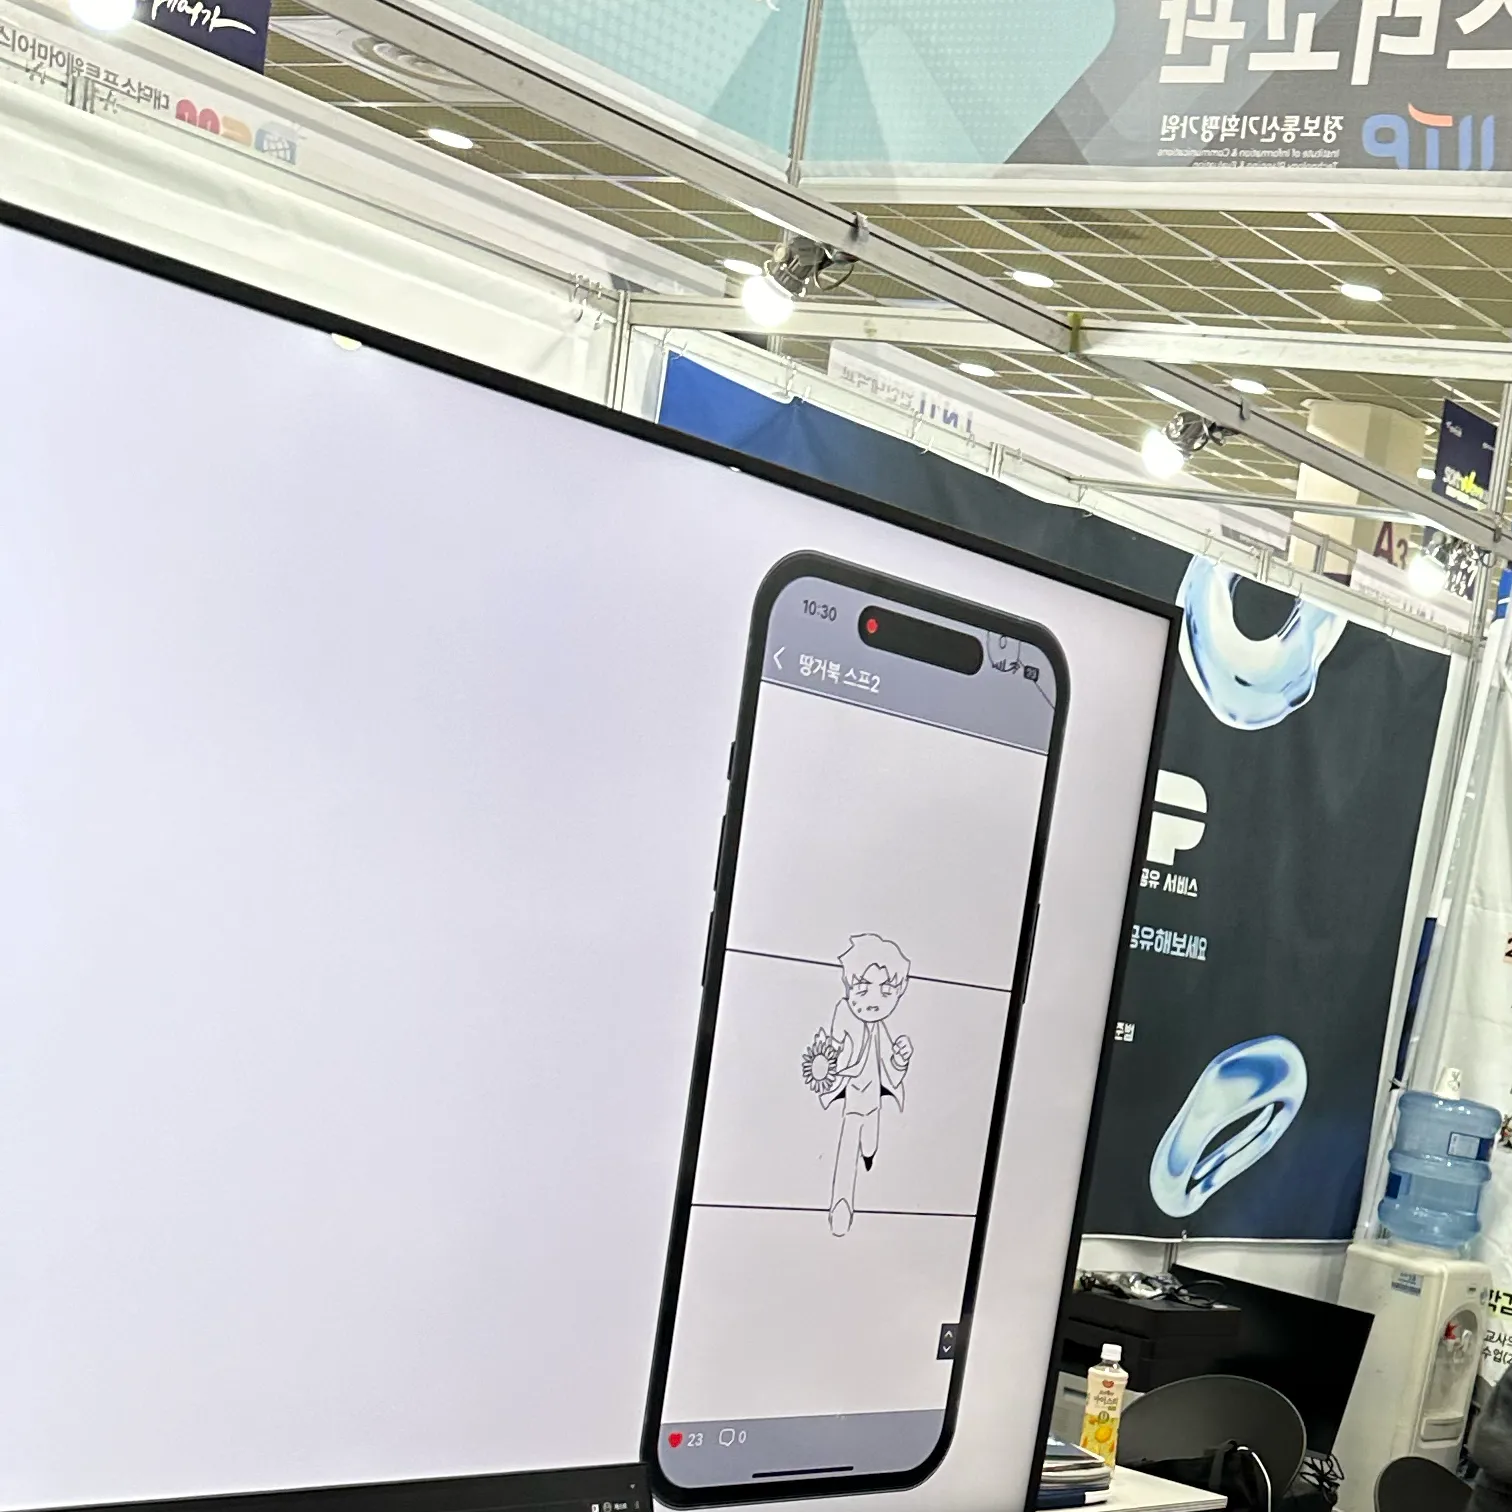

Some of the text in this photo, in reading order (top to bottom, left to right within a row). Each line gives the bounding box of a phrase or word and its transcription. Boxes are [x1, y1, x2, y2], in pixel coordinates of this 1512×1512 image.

[803, 599, 838, 622] 10:30
[1163, 873, 1199, 898] 서비스
[687, 1433, 704, 1447] 23
